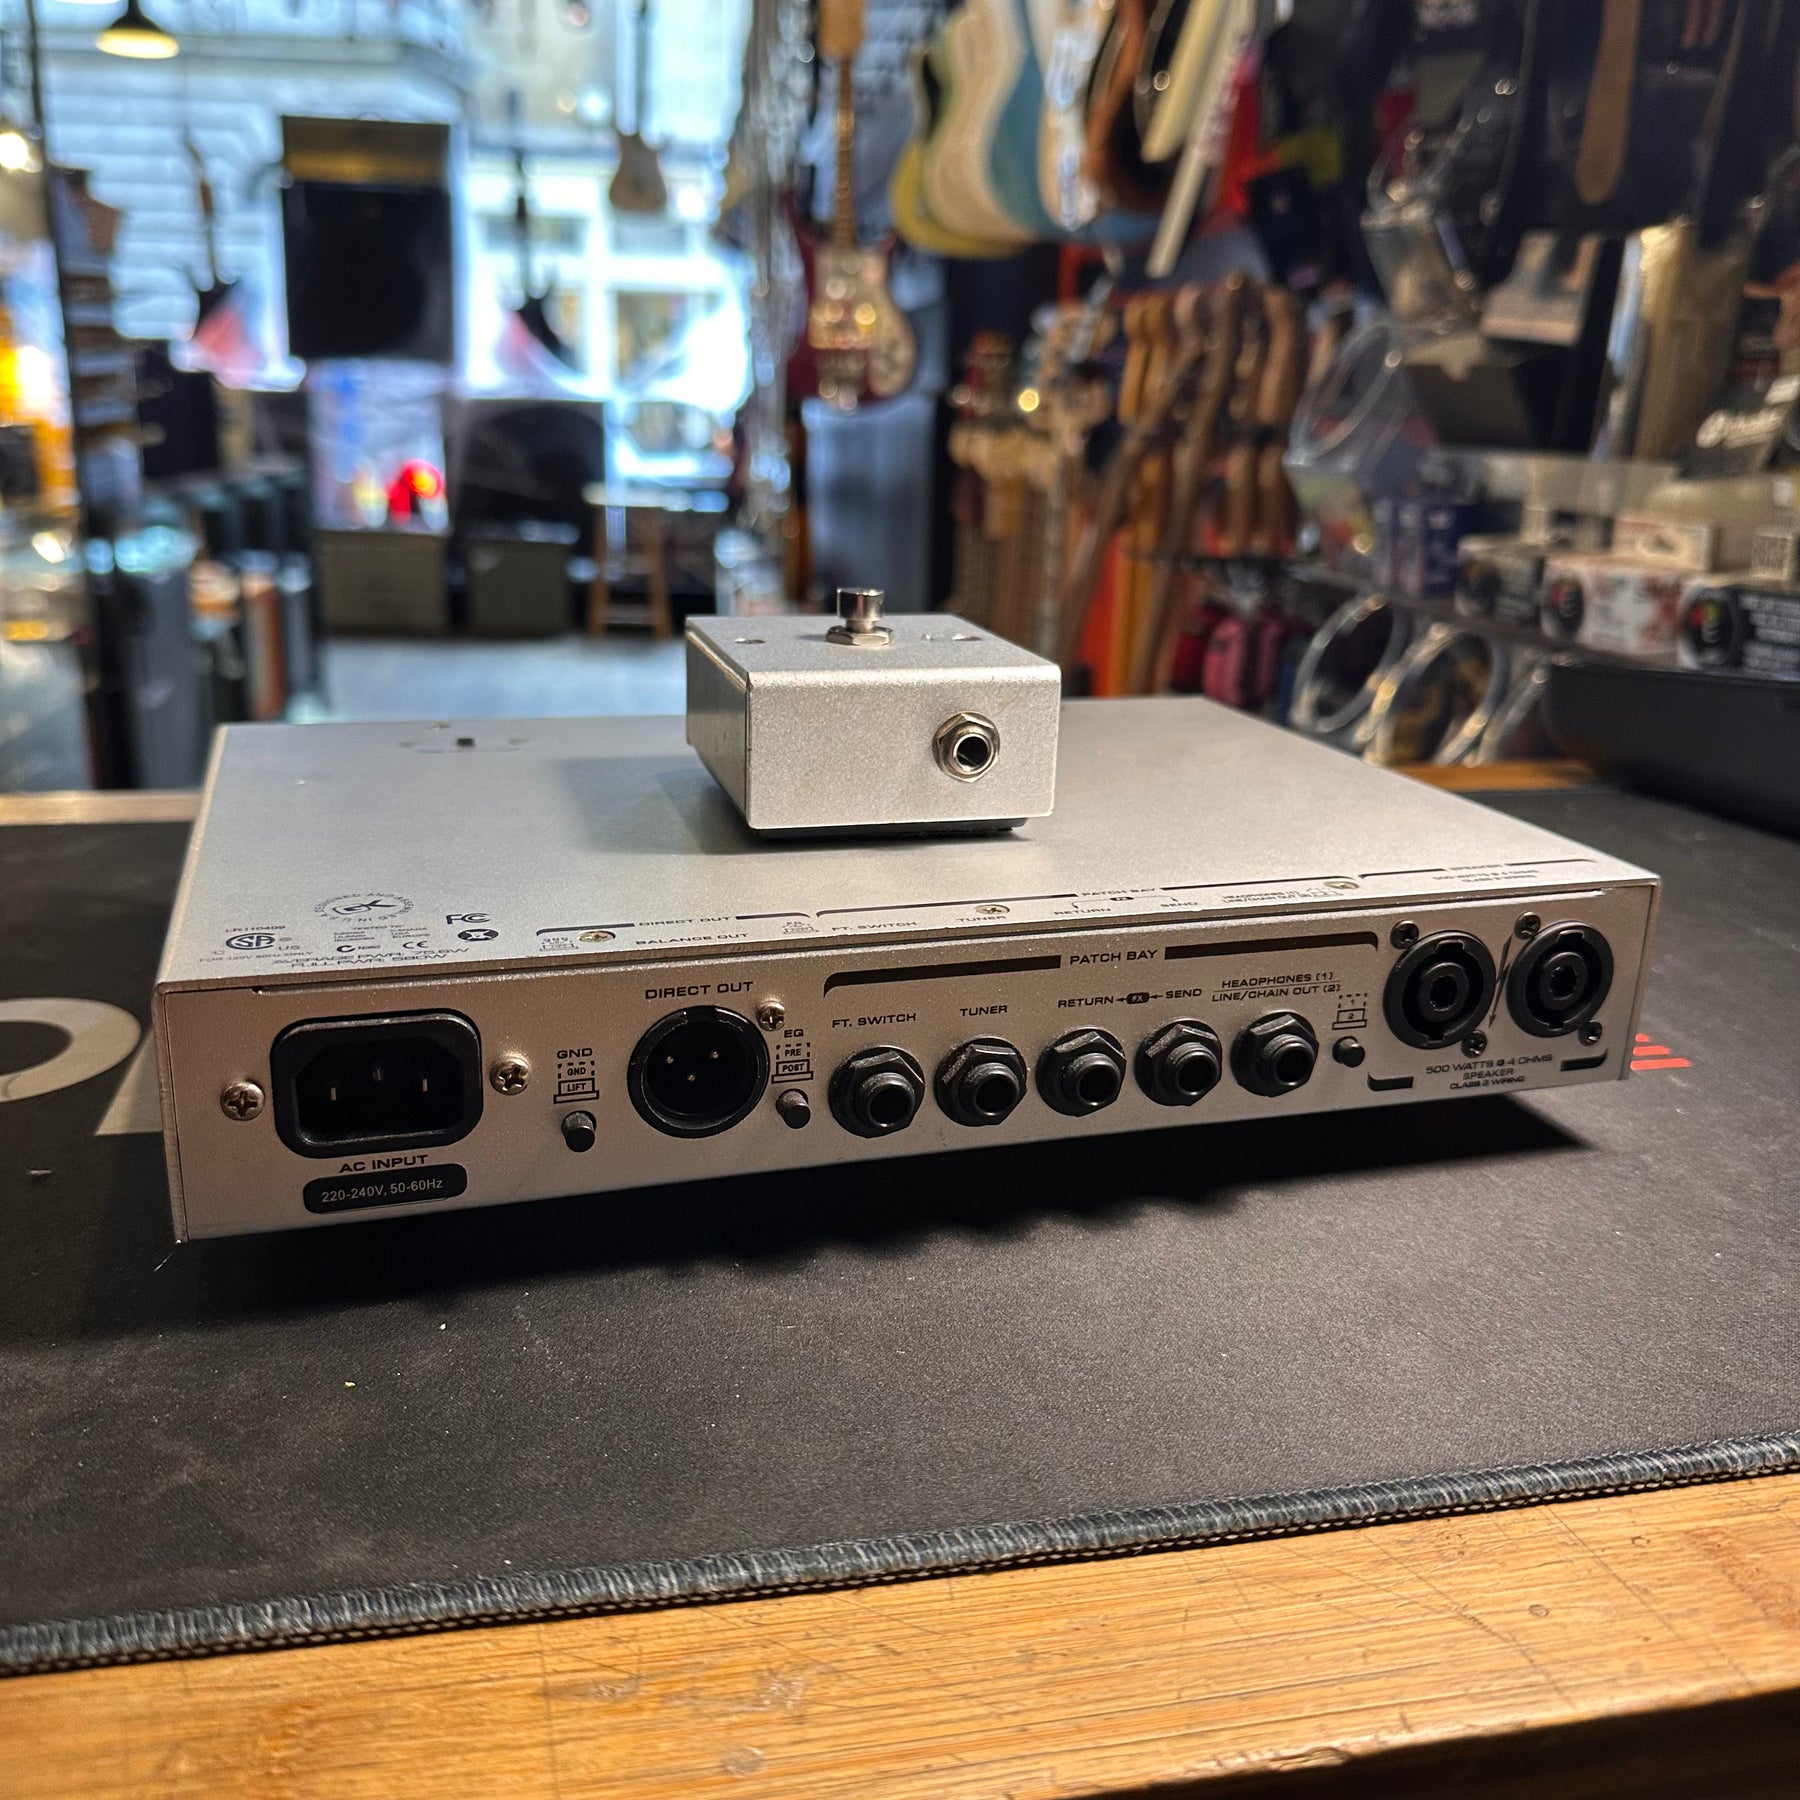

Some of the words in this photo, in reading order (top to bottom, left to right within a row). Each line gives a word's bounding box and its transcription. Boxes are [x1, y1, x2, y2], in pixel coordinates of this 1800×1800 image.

[857, 921, 918, 930] SWITCH
[636, 935, 712, 945] BALANCE
[1070, 952, 1121, 966] PATCH
[1126, 950, 1158, 961] BAY
[1222, 973, 1312, 988] HEADPHONES
[1316, 972, 1334, 981] (1)
[645, 985, 711, 1000] DIRECT
[717, 982, 754, 994] OUT
[1212, 988, 1289, 1002] LINE/CHAIN
[1292, 986, 1320, 996] OUT
[1323, 984, 1341, 993] (2)
[1058, 996, 1114, 1008] RETURN
[1165, 988, 1202, 999] SEND
[959, 1004, 1008, 1017] TUNER
[832, 1018, 852, 1028] FT.
[858, 1013, 917, 1026] SWITCH
[784, 1028, 804, 1039] EQ
[557, 1048, 592, 1059] GND
[784, 1048, 802, 1058] PRE
[782, 1063, 805, 1072] POST
[1426, 1064, 1450, 1074] 500
[1452, 1060, 1494, 1072] WATTS
[1506, 1058, 1516, 1066] 4
[1518, 1054, 1553, 1064] OHMS
[567, 1067, 586, 1076] GND
[1463, 1068, 1514, 1080] SPEAKER
[567, 1082, 586, 1092] LIFT
[1450, 1080, 1480, 1090] CLASS
[1482, 1079, 1490, 1087] 2
[1491, 1076, 1526, 1086] WIRING
[339, 1162, 366, 1174] AC
[372, 1154, 429, 1170] INPUT
[321, 1184, 388, 1203] 220-240V,
[390, 1178, 444, 1194] 50-60Hz
